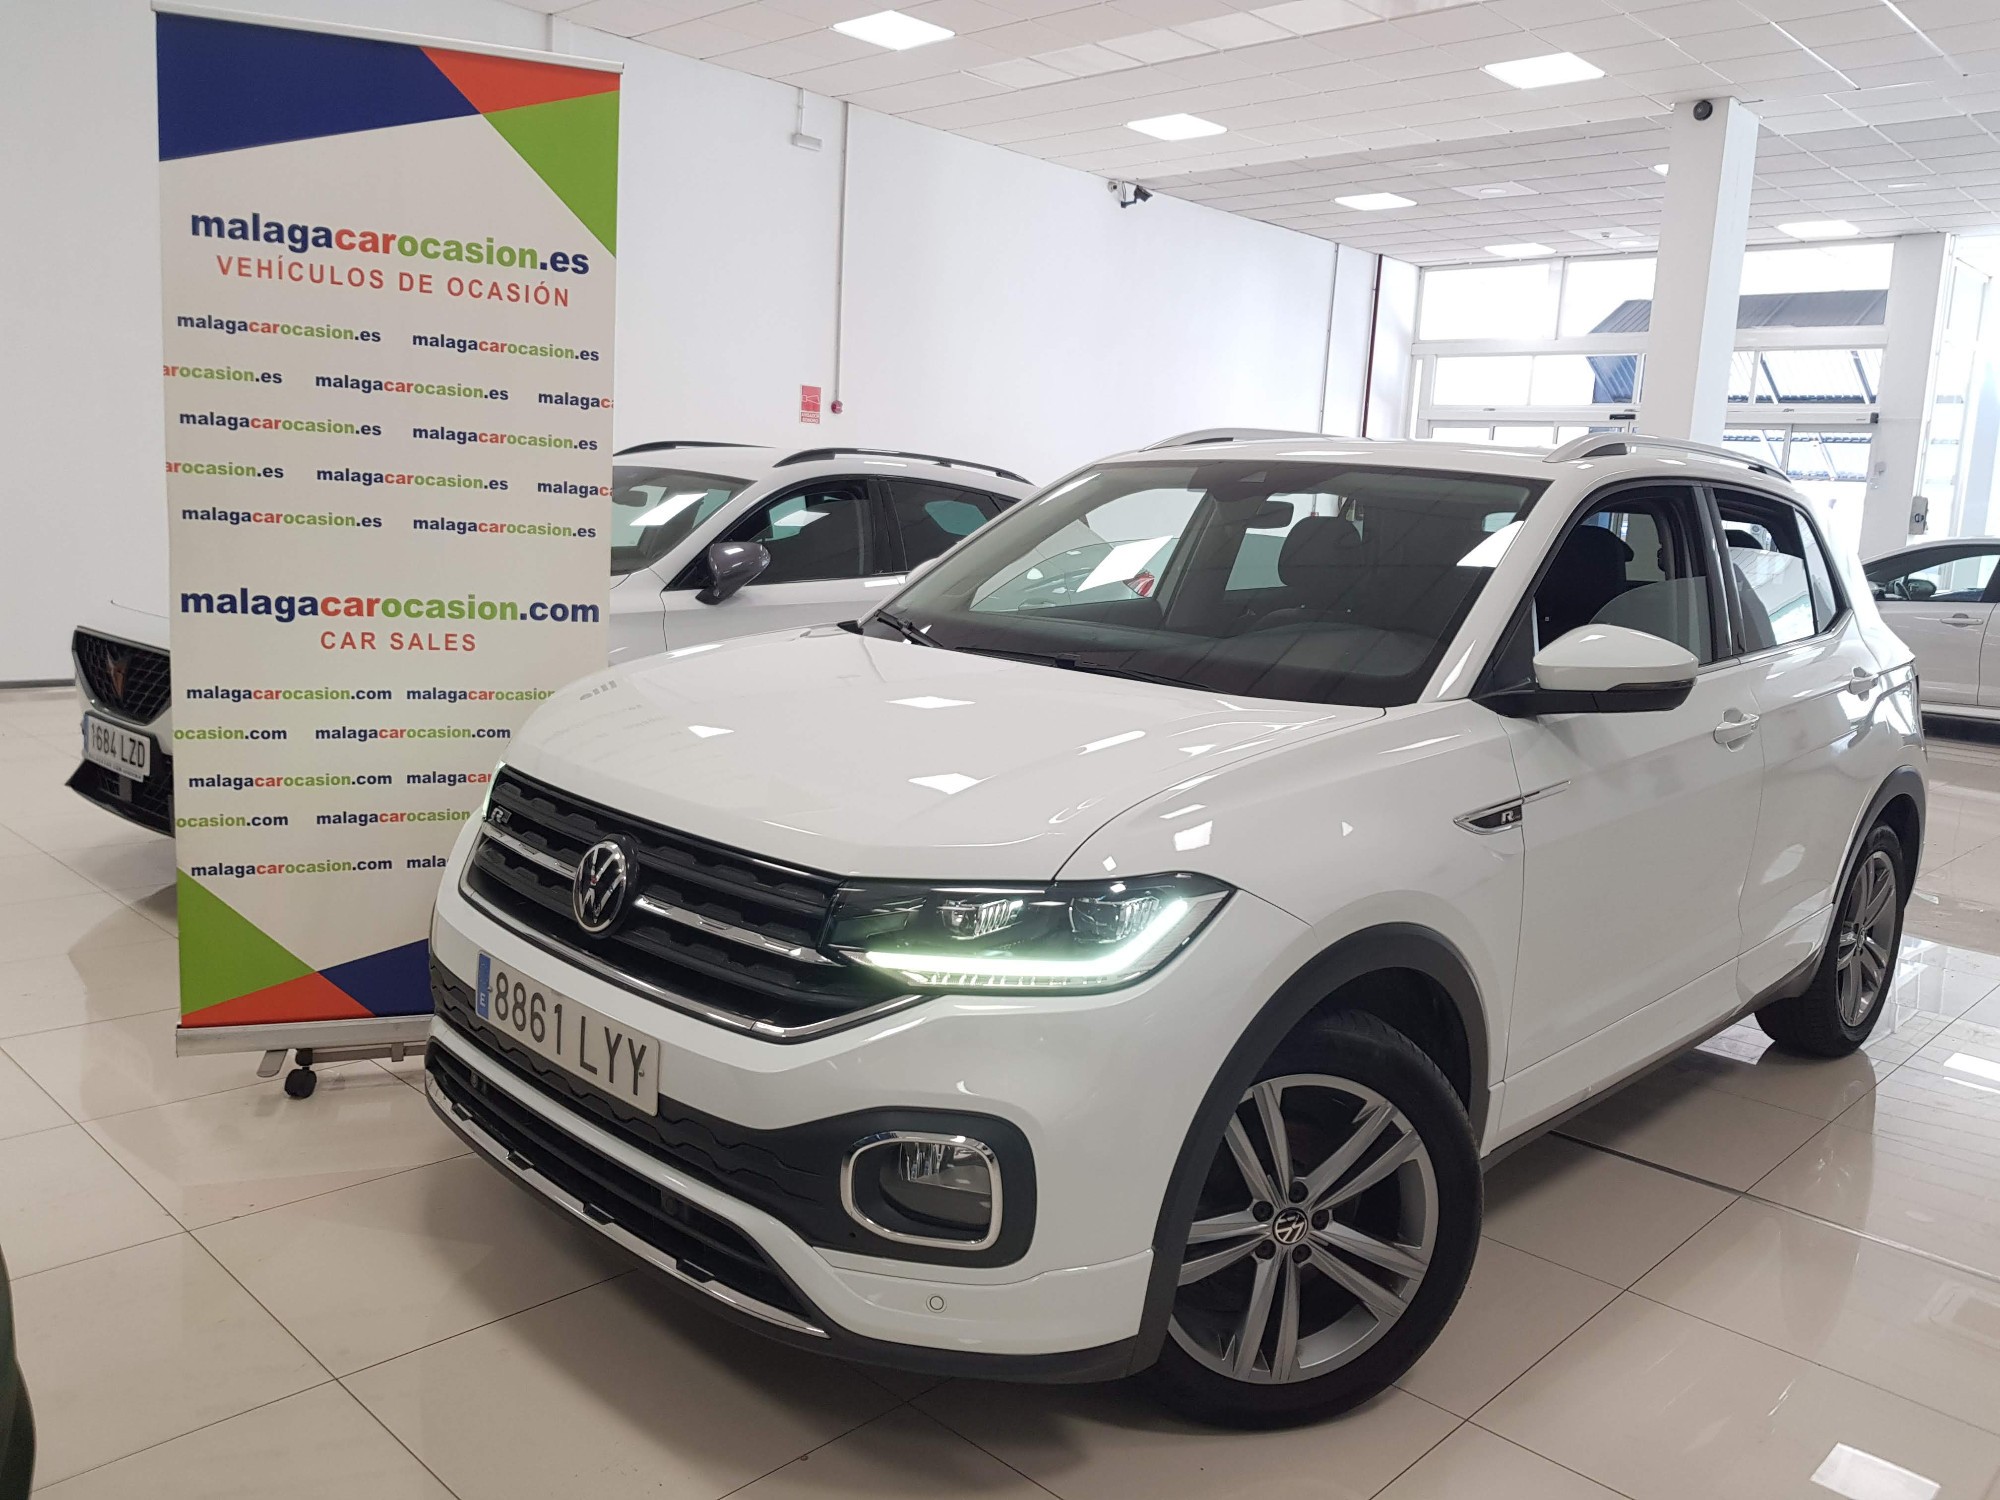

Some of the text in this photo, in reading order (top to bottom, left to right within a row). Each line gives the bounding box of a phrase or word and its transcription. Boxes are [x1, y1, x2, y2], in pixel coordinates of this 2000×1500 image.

[191, 212, 590, 275] malagacarocasion.es
[216, 255, 568, 308] VEHÍCULOS DE OCASIÓN
[177, 315, 599, 361] malagacarocasion.es malagacarocasion.es
[316, 375, 508, 400] malagacarocasion.es
[180, 412, 597, 450] malagacarocasion.es malagacarocasion.es
[317, 468, 508, 490] malagacarocasion.es
[182, 507, 596, 538] malagacarocasion.es malagacarocasion.es
[181, 587, 599, 623] malagacarocasion.com
[321, 631, 475, 651] CAR SALES
[187, 686, 392, 703] malagacarocasion.com
[91, 723, 117, 757] 1684
[121, 735, 145, 768] LZD
[174, 726, 510, 742] ocasion.com malagacarocasion.com
[189, 773, 392, 790] malagacarocasion.com
[177, 814, 288, 827] ocasion.com
[191, 855, 447, 878] malagacarocasion.com mala
[495, 972, 647, 1096] 8861 LYY
